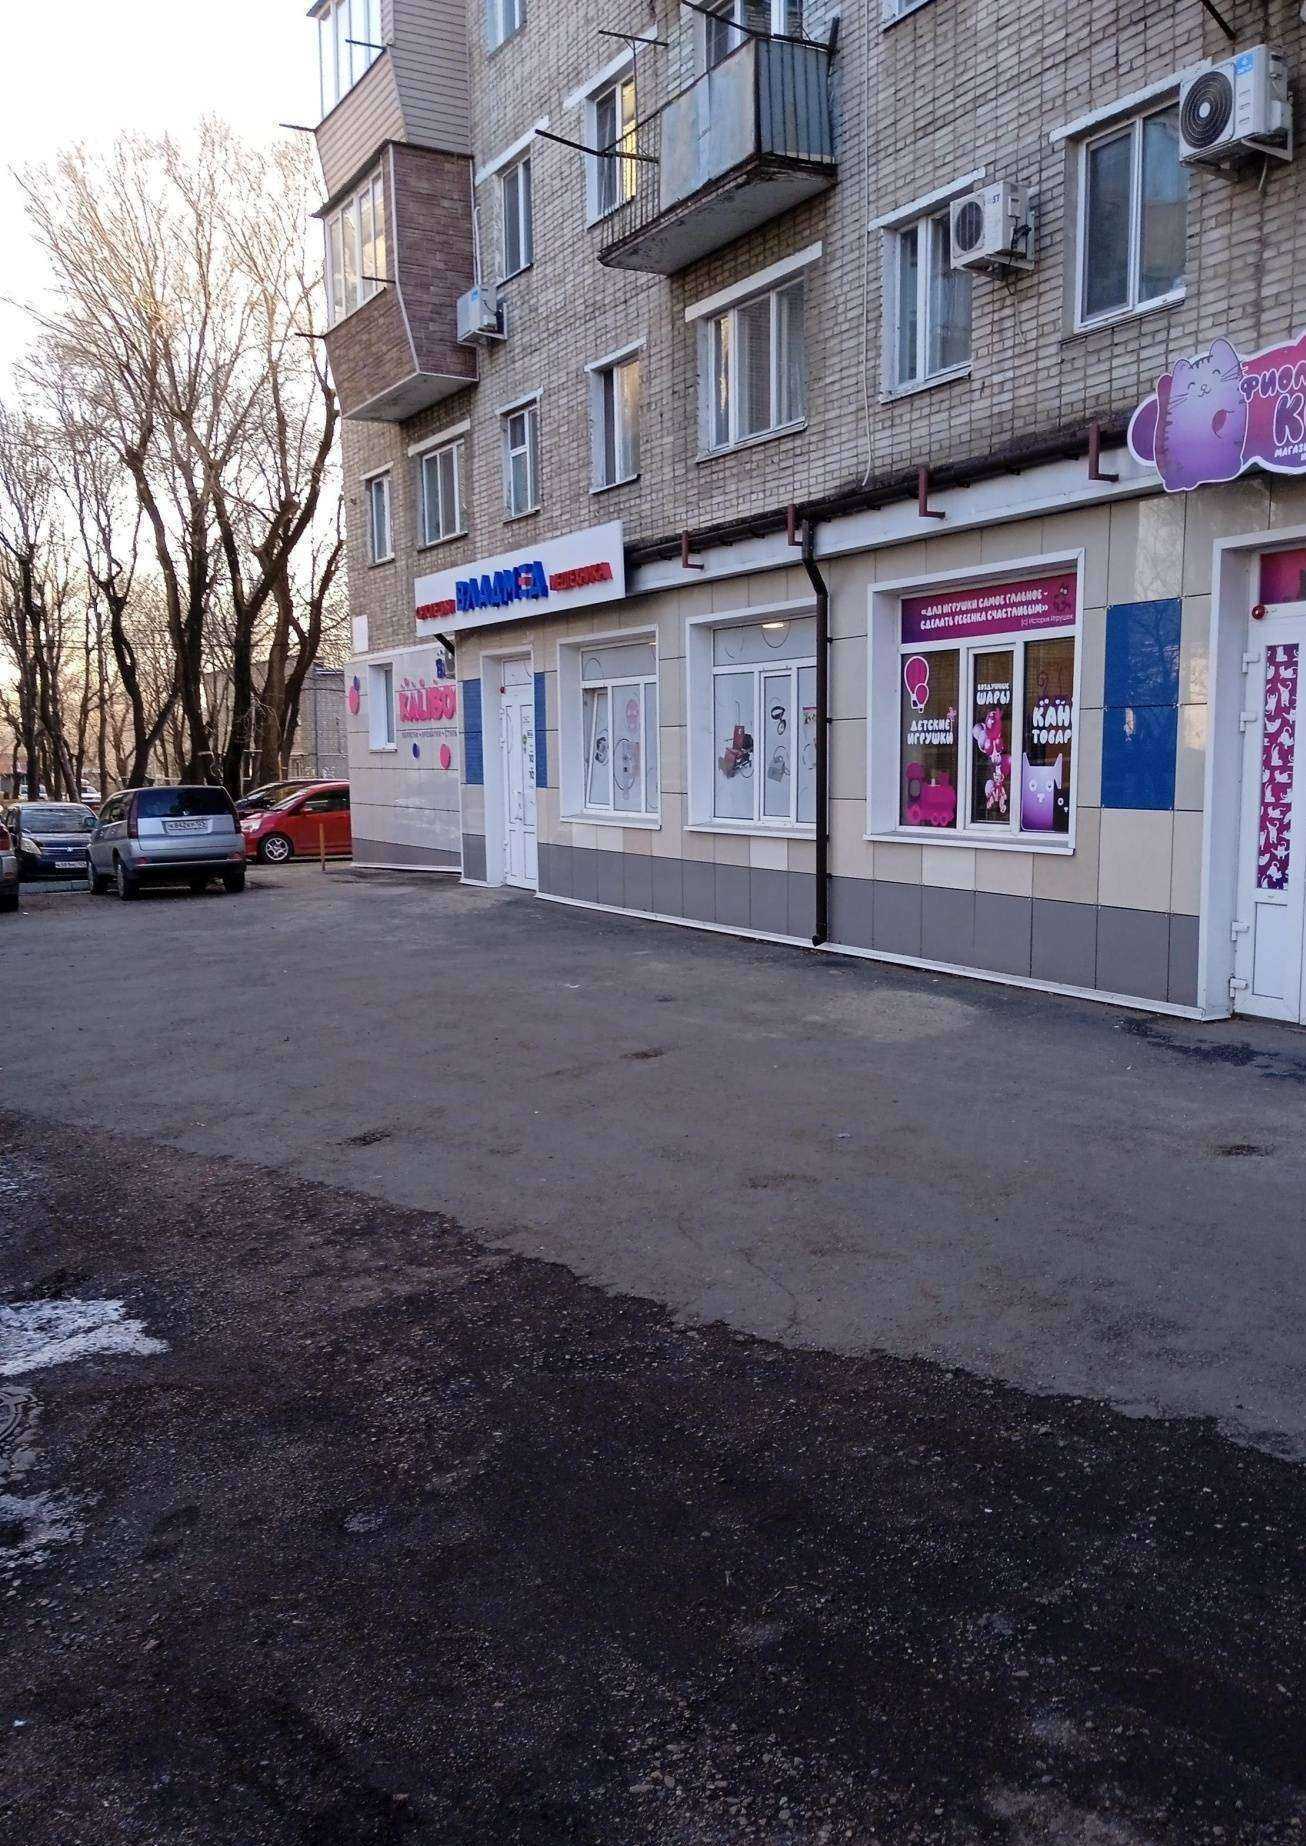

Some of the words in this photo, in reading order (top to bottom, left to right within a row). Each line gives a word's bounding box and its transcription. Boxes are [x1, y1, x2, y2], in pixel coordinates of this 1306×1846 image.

[1273, 393, 1306, 447] К
[1274, 442, 1306, 458] МАГАЗ
[943, 599, 977, 613] ИГРУШКИ
[978, 596, 1005, 607] САМОЕ
[920, 617, 954, 630] СДЕЛАТЬ
[976, 690, 1010, 705] ШАРЫ
[1032, 705, 1071, 727] КАН
[910, 719, 951, 731] ДЕТСКИЕ
[907, 731, 954, 745] ИГРУШКИ
